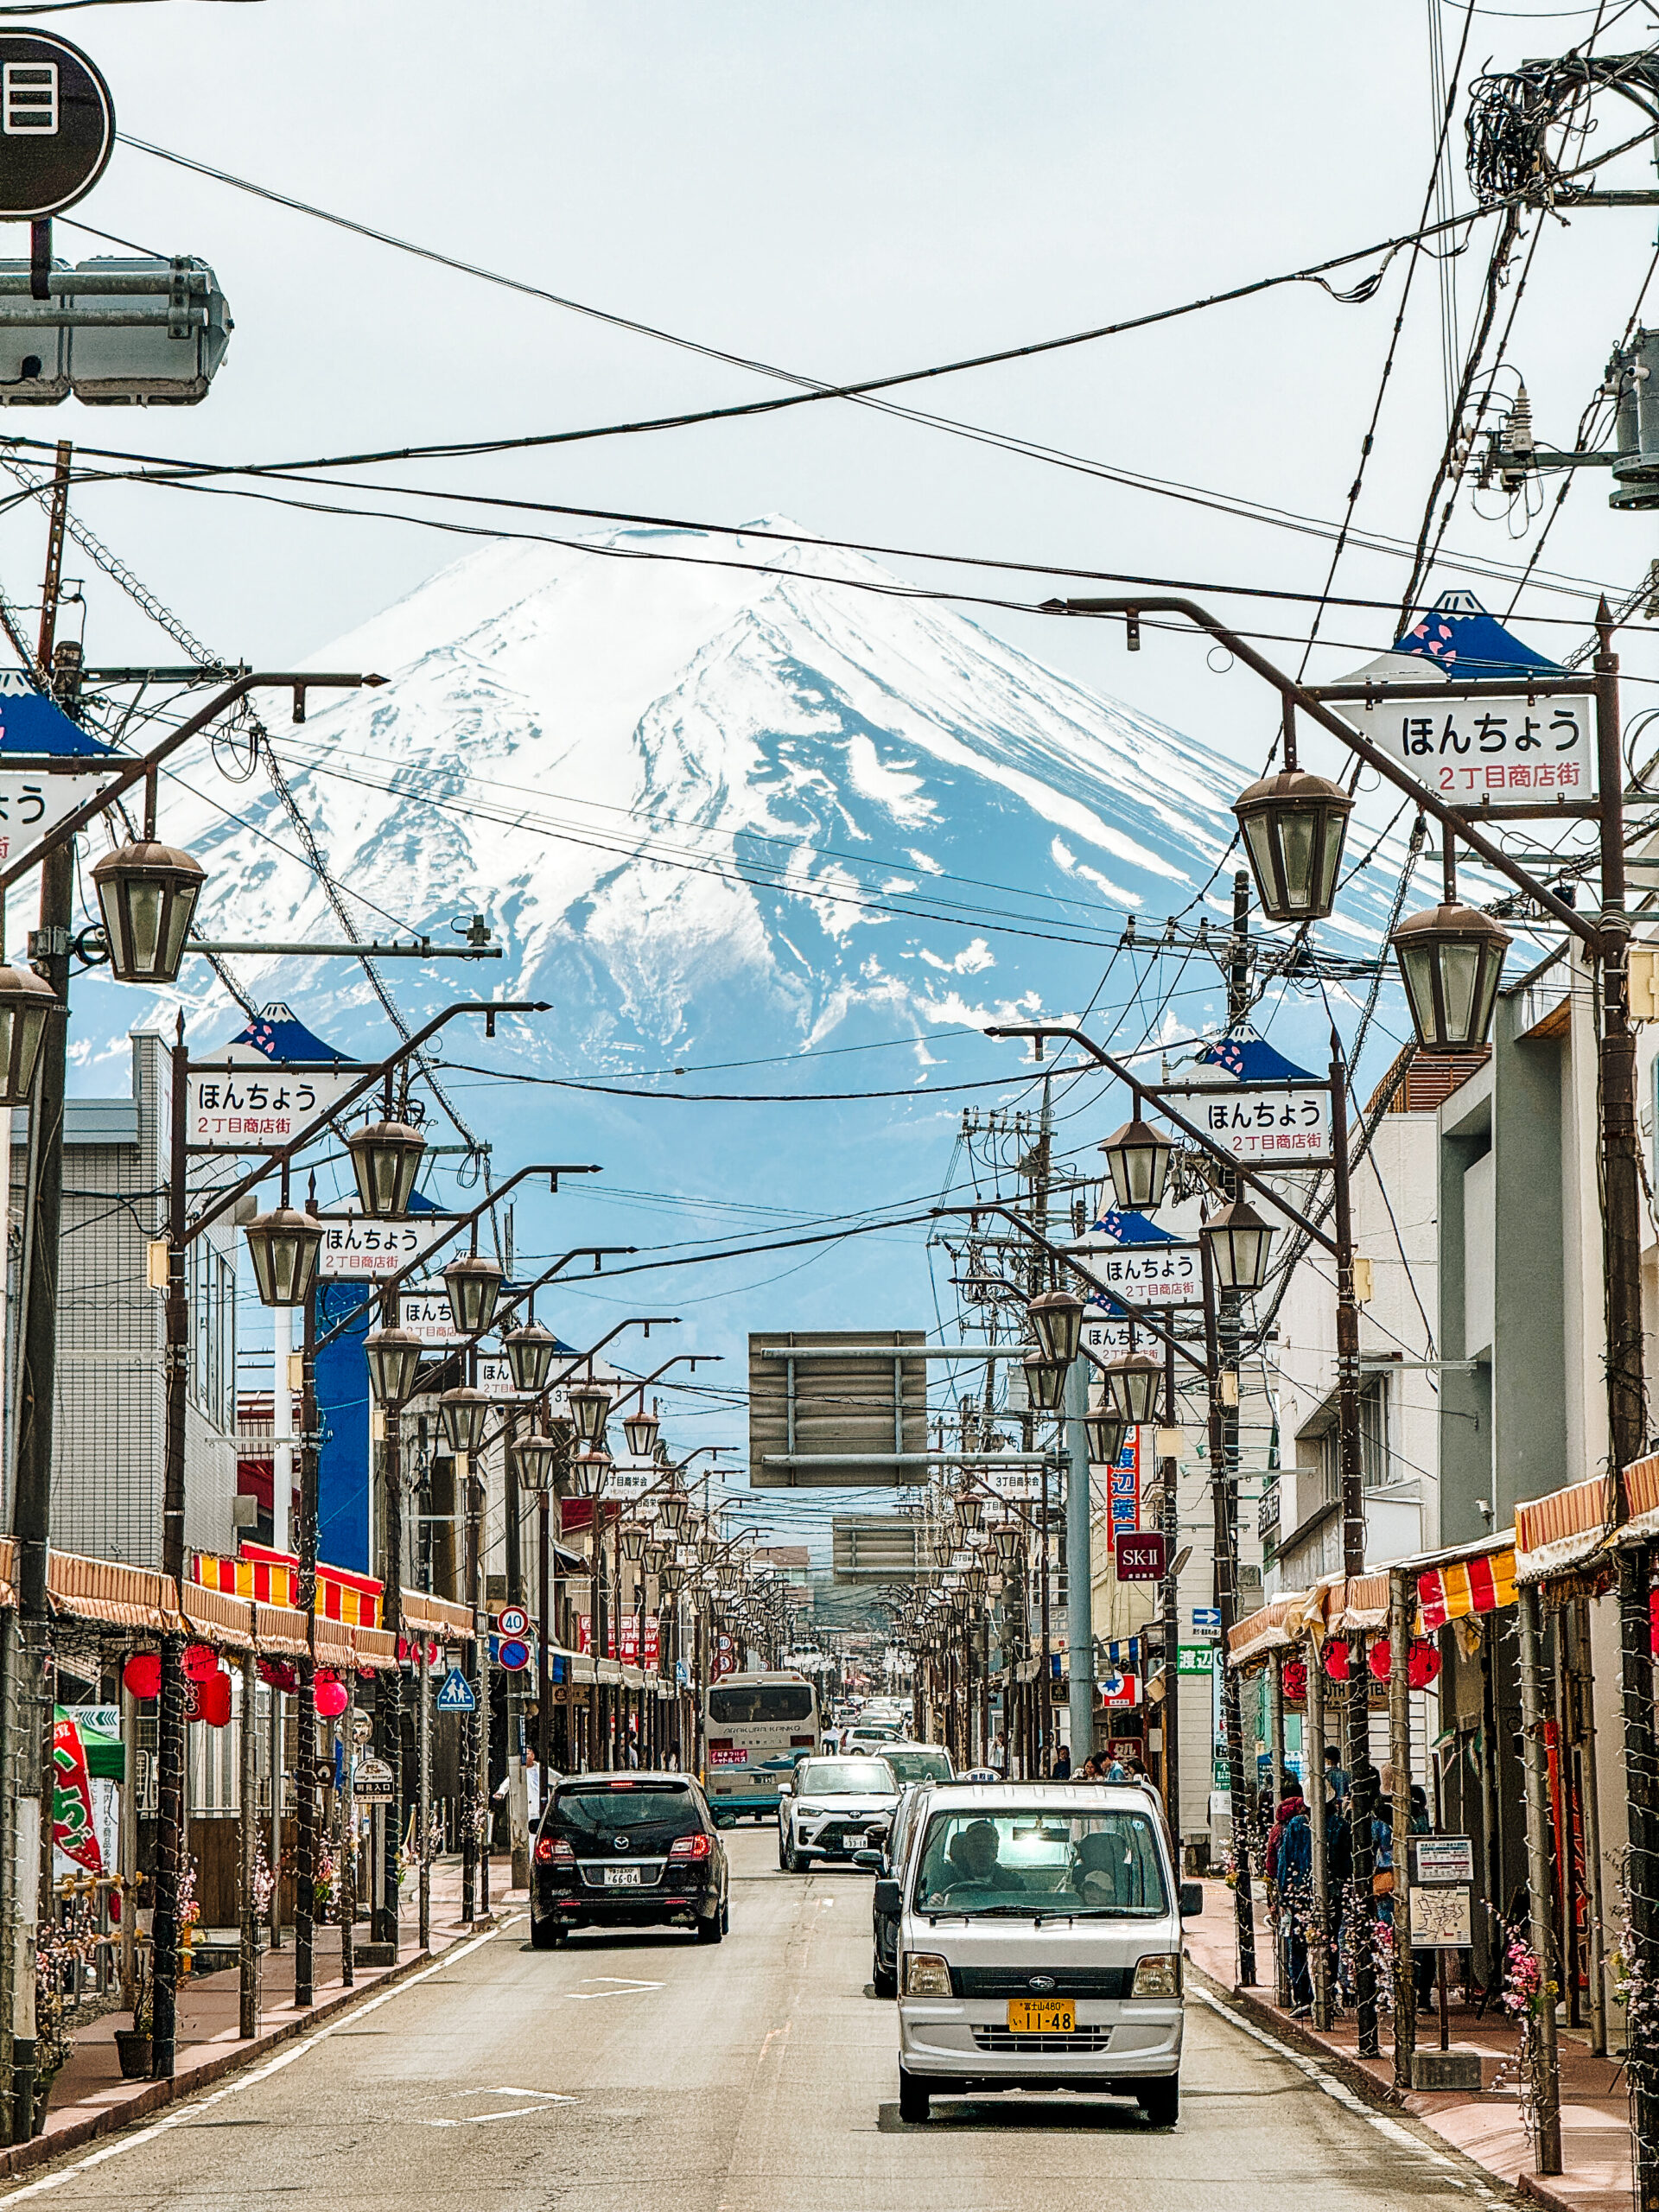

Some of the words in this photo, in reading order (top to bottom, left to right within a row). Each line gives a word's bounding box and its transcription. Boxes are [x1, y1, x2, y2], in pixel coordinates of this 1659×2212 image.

[1402, 709, 1580, 756] ほんちょう
[1439, 761, 1580, 790] 2丁目商店街
[199, 1083, 316, 1111] ほんちょう
[1209, 1099, 1320, 1129] ほんちょう
[198, 1117, 291, 1134] 2丁目商店街
[1232, 1133, 1322, 1151] 2丁目商店街
[327, 1229, 417, 1251] ほんちょう
[326, 1255, 398, 1268] 2丁目商店街
[1107, 1256, 1192, 1281] ほんちょう
[1125, 1281, 1194, 1297] 2丁目商店街
[505, 1615, 522, 1630] 40
[613, 1873, 638, 1884] 66-04
[1027, 2012, 1071, 2030] 11-48
